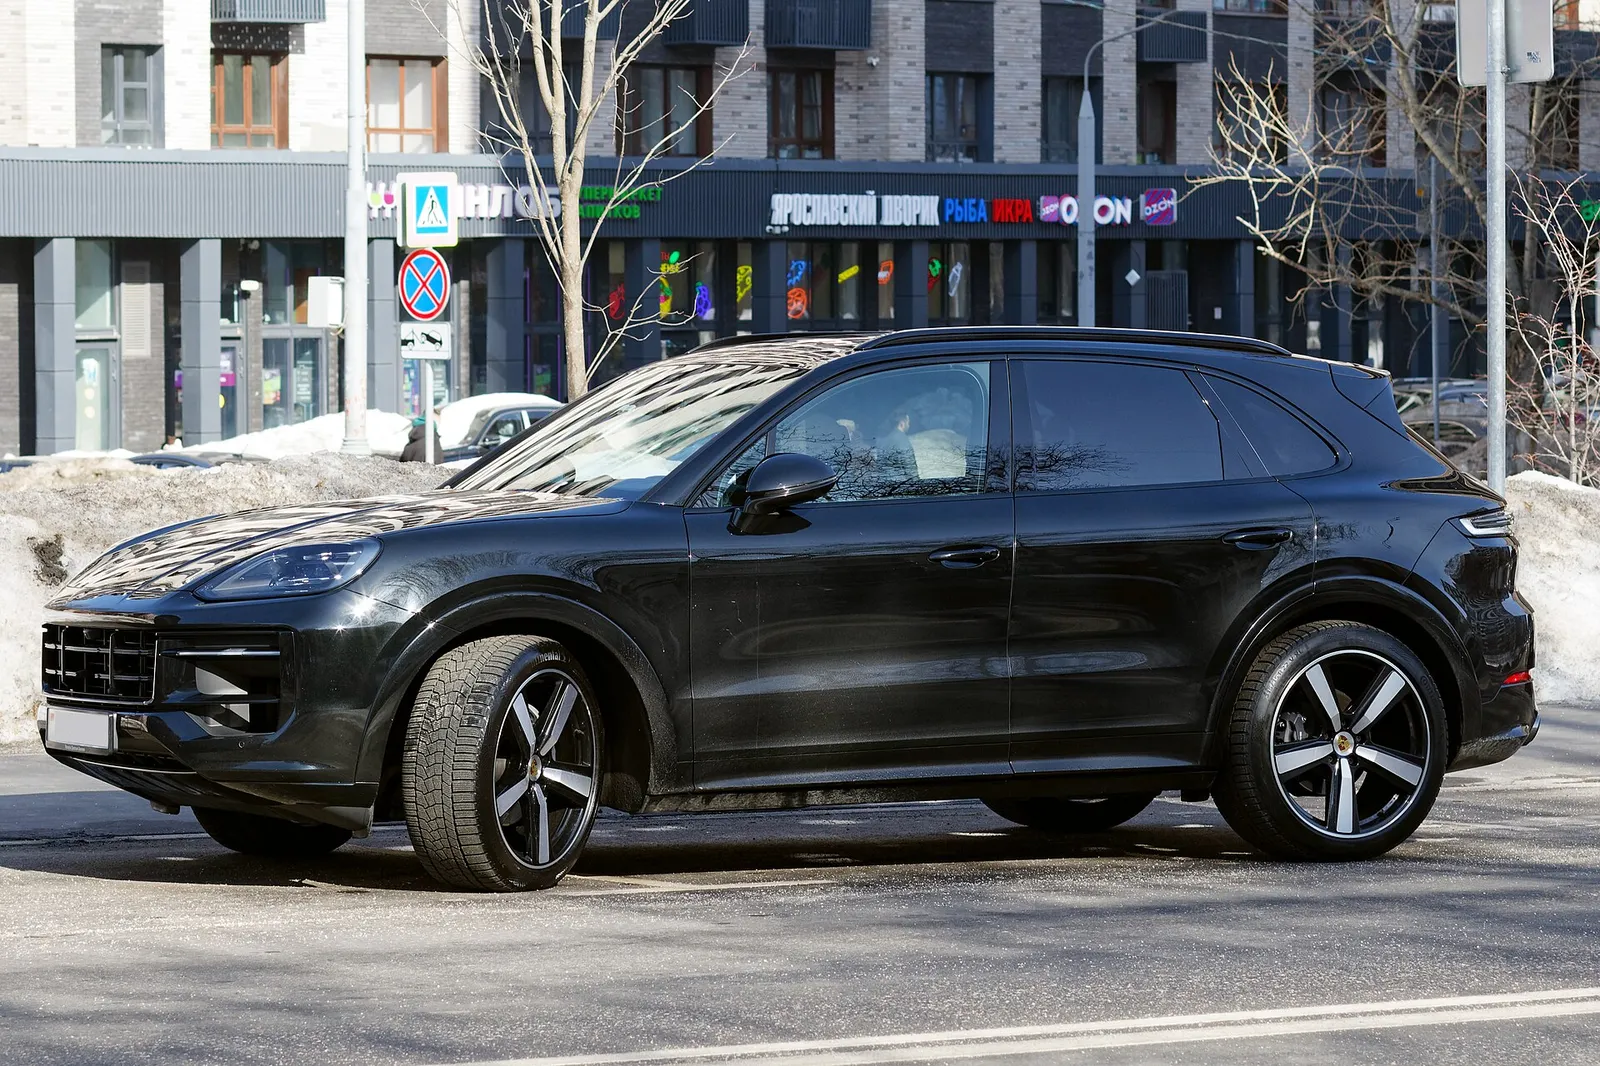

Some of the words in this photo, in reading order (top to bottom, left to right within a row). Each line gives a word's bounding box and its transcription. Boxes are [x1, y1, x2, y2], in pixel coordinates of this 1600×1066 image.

[771, 190, 877, 226] ЯРОСЛАВСКИЙ
[880, 195, 940, 226] ДВОРИК
[944, 198, 988, 222] РЫБА
[992, 198, 1034, 223] ИКРА
[1061, 196, 1132, 225] OON
[1144, 197, 1174, 216] OZON
